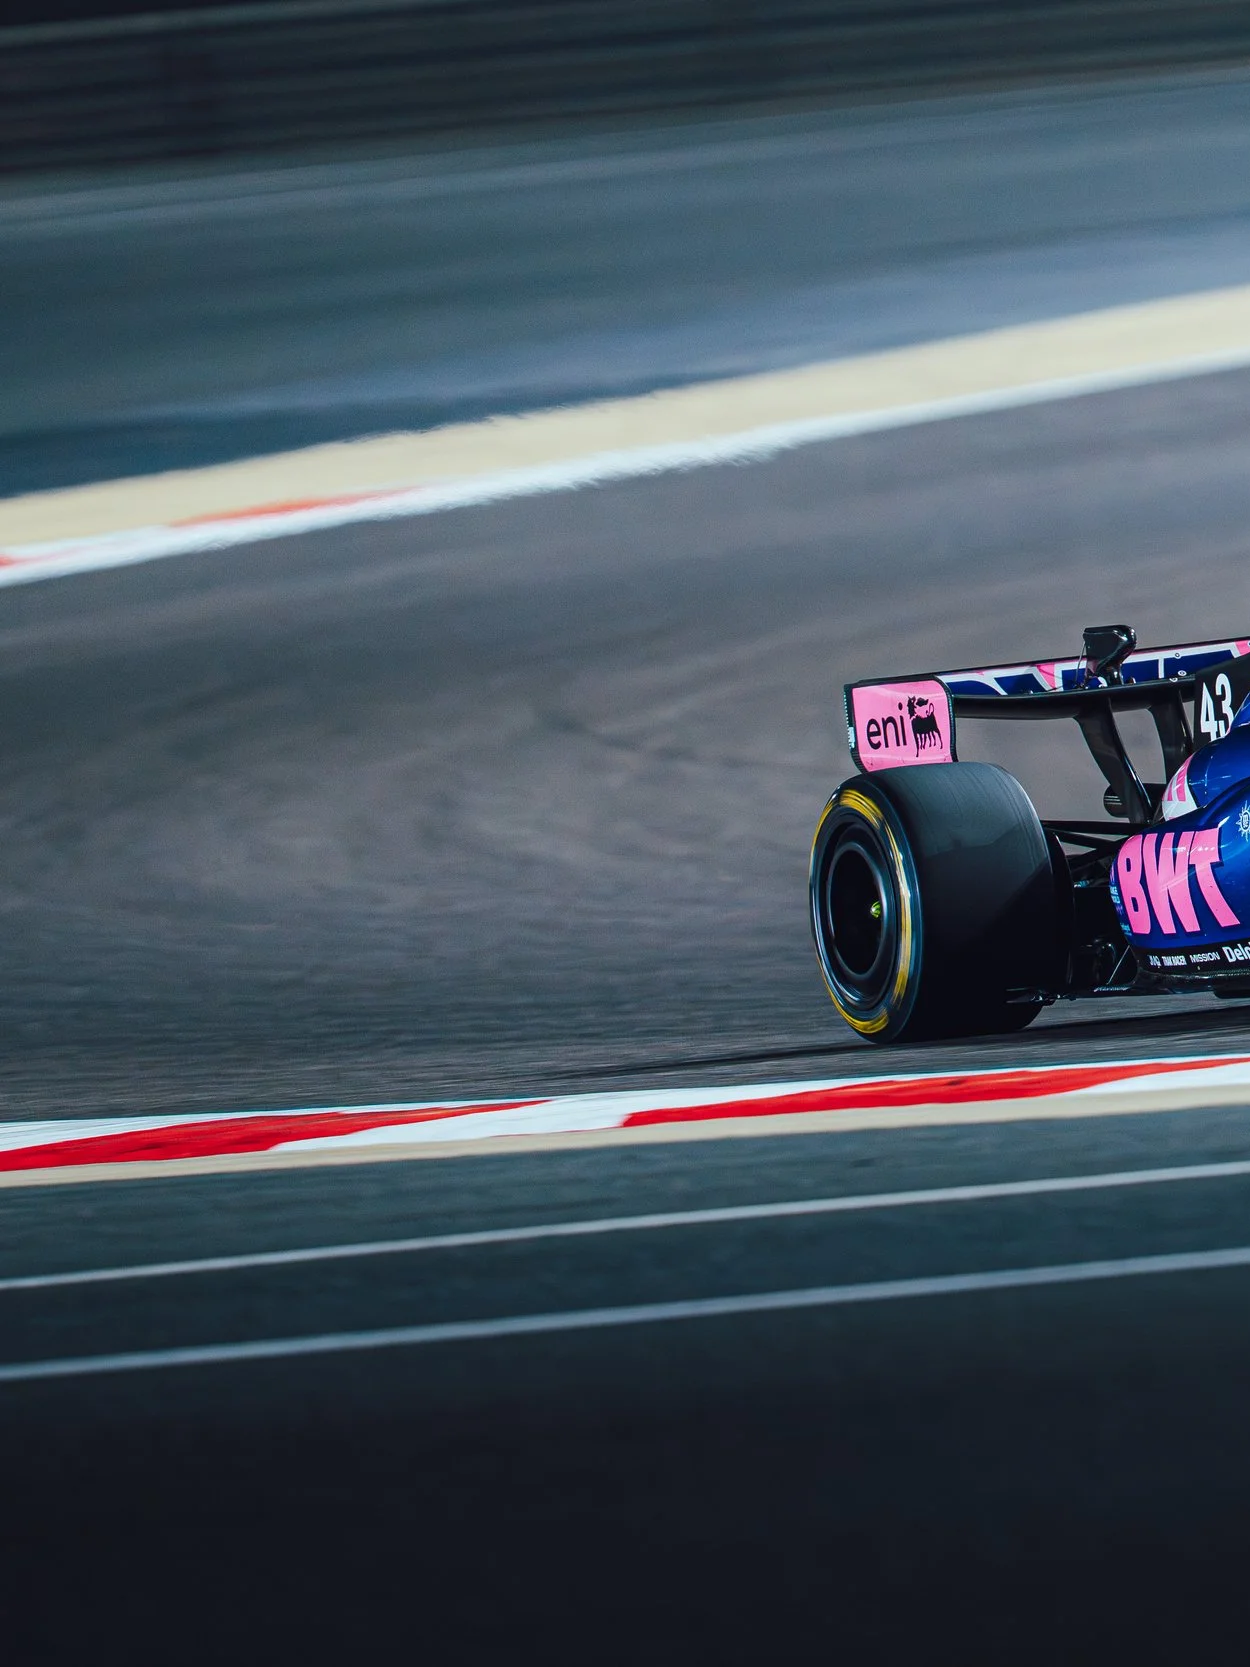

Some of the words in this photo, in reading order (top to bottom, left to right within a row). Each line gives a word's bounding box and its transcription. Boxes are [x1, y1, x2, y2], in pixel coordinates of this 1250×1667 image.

[866, 702, 907, 750] eni
[1200, 673, 1234, 741] 43
[1117, 827, 1241, 935] BWT
[1189, 951, 1221, 963] MISSION
